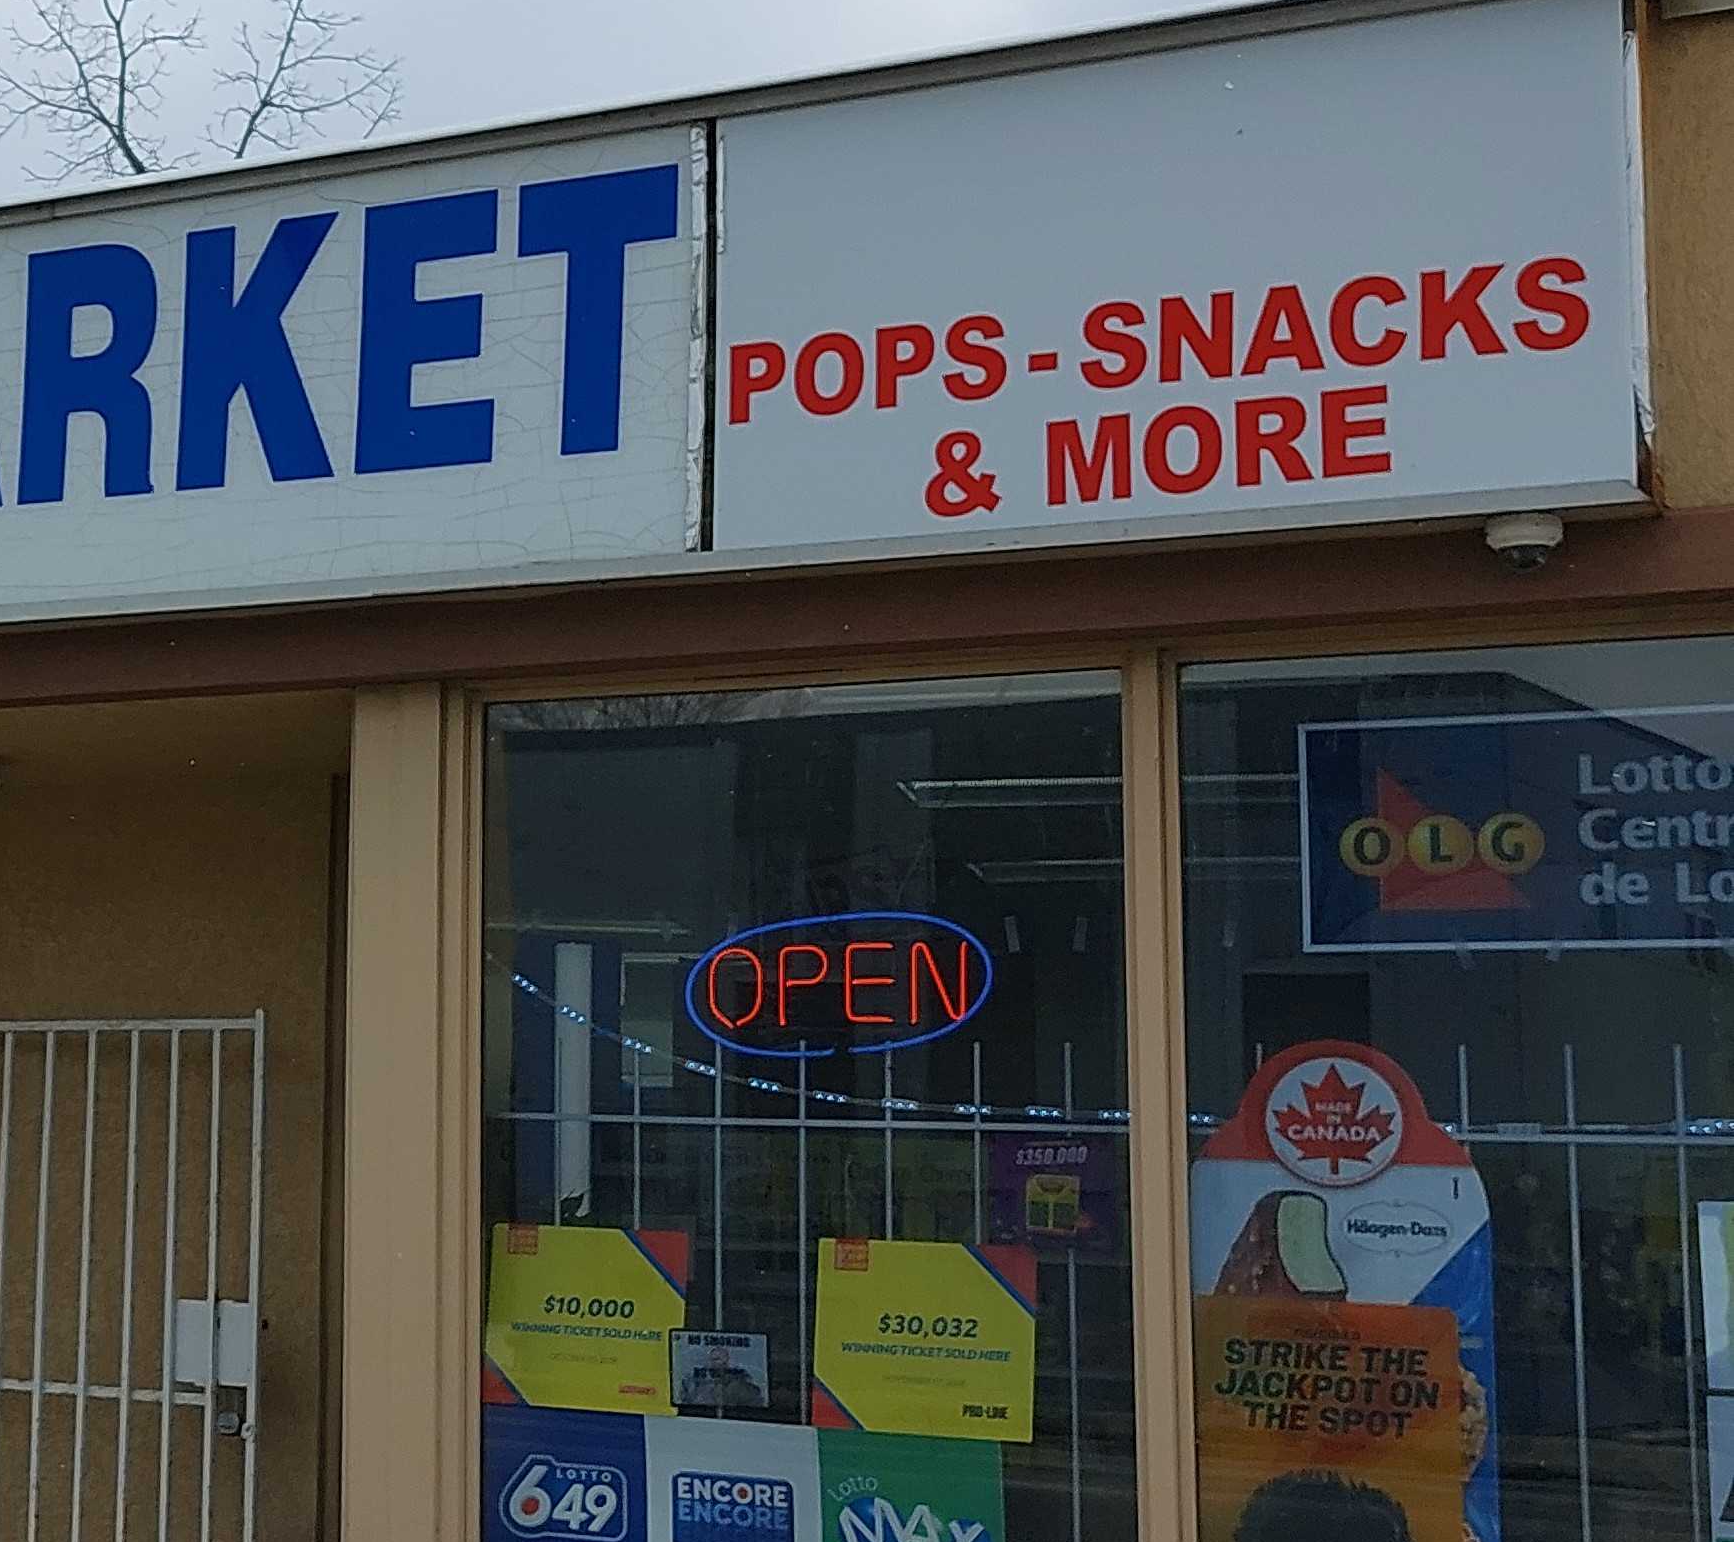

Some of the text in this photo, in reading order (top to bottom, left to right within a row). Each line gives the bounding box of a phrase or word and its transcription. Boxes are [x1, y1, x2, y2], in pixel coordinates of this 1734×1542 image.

[924, 385, 1392, 518] & MORE
[1577, 753, 1734, 794] Lotto
[1579, 861, 1650, 906] de
[708, 940, 970, 1028] OPEN
[1287, 1122, 1383, 1142] CANADA
[1346, 1219, 1448, 1239] Häagen-Dazs
[544, 1295, 635, 1319] $10,000
[510, 1322, 561, 1335] WINNING
[563, 1325, 601, 1338] TICKET
[603, 1328, 632, 1340] SOLD
[878, 1313, 979, 1339] $30,032
[841, 1341, 1011, 1362] WINNING TICKET SOLD HERE
[1224, 1338, 1429, 1378] STRIKE THE
[1216, 1370, 1440, 1409] JACKPOT ON
[1243, 1399, 1412, 1440] THE SPOT
[556, 1469, 612, 1483] LOTTO
[827, 1476, 878, 1501] Lotto
[509, 1465, 617, 1532] 649
[677, 1477, 789, 1507] ENCORE
[678, 1499, 789, 1529] ENCORE
